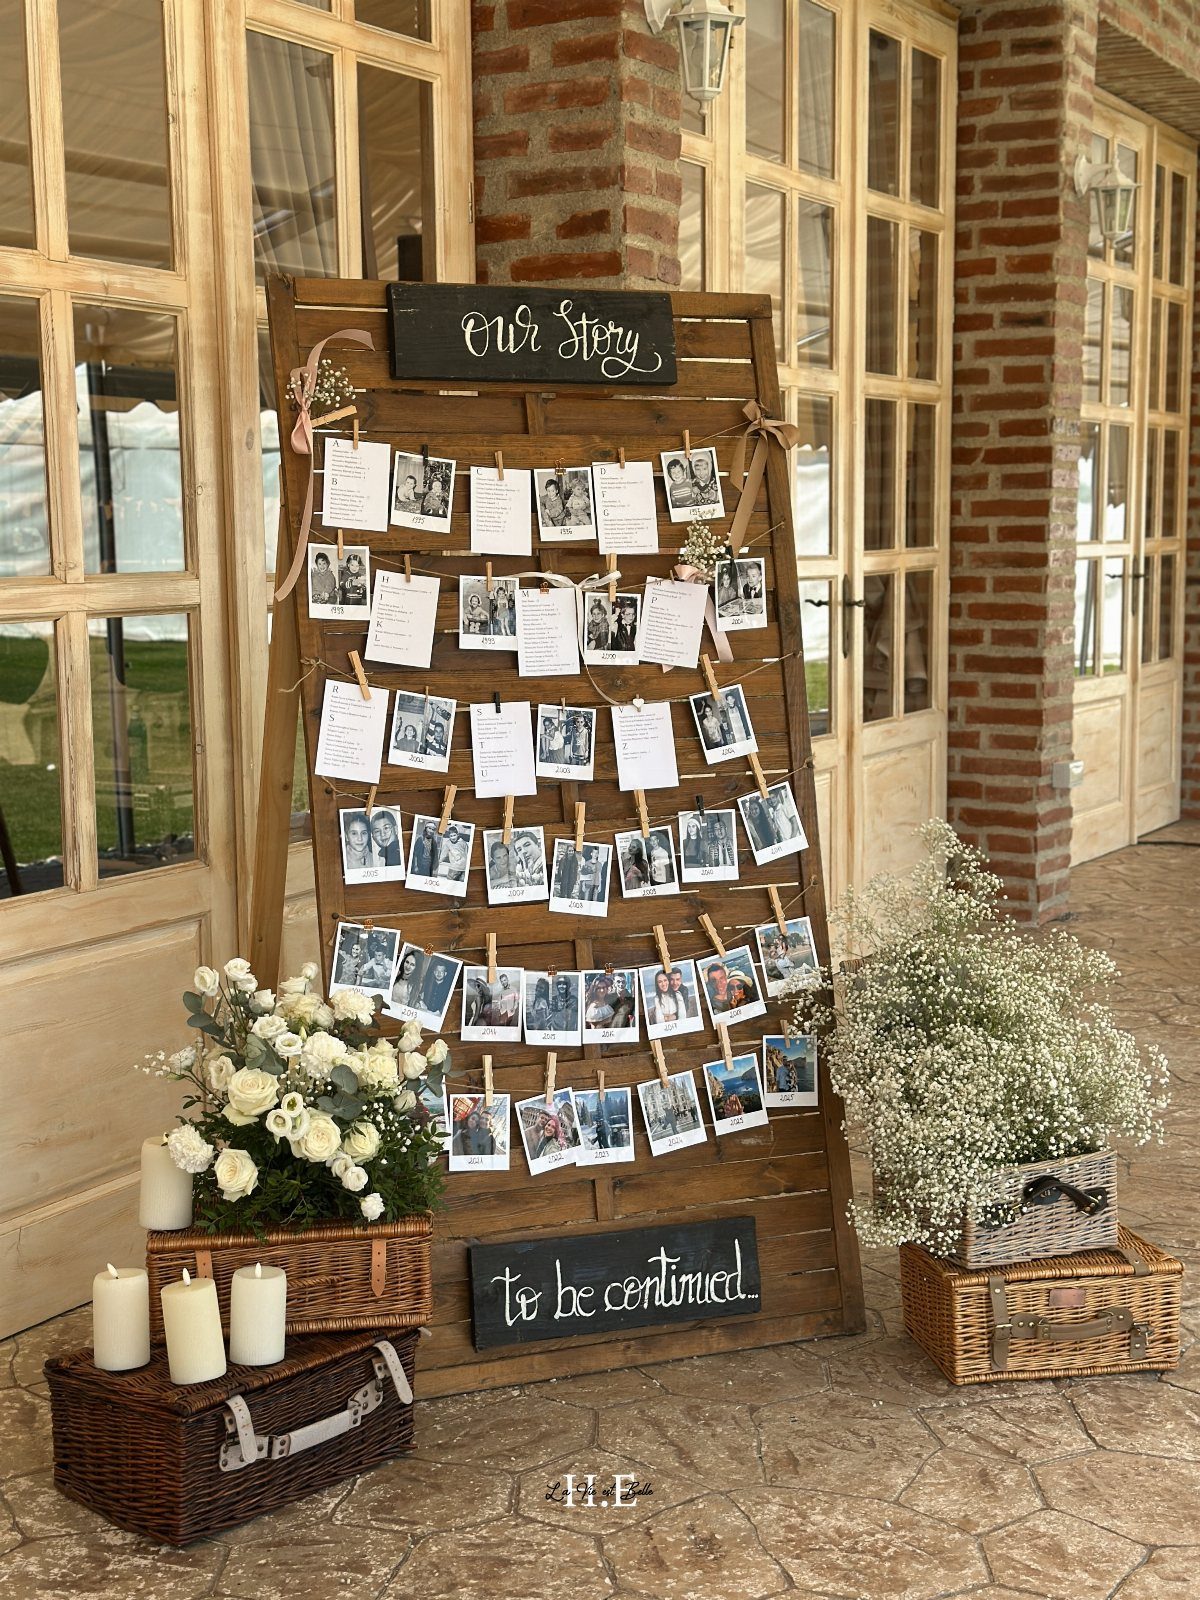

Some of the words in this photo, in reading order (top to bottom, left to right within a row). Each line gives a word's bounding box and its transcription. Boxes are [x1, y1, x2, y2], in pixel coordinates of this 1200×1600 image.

[462, 304, 541, 357] Our
[553, 299, 662, 378] Story
[476, 467, 483, 476] C
[600, 467, 607, 475] D
[331, 477, 338, 486] B
[603, 509, 610, 517] G
[651, 596, 658, 604] P
[332, 685, 339, 693] R
[477, 708, 483, 716] S
[329, 713, 335, 722] S
[481, 769, 488, 777] U
[401, 1008, 418, 1019] 2013
[594, 1150, 610, 1159] 2023
[490, 1266, 543, 1327] to
[553, 1259, 595, 1320] be
